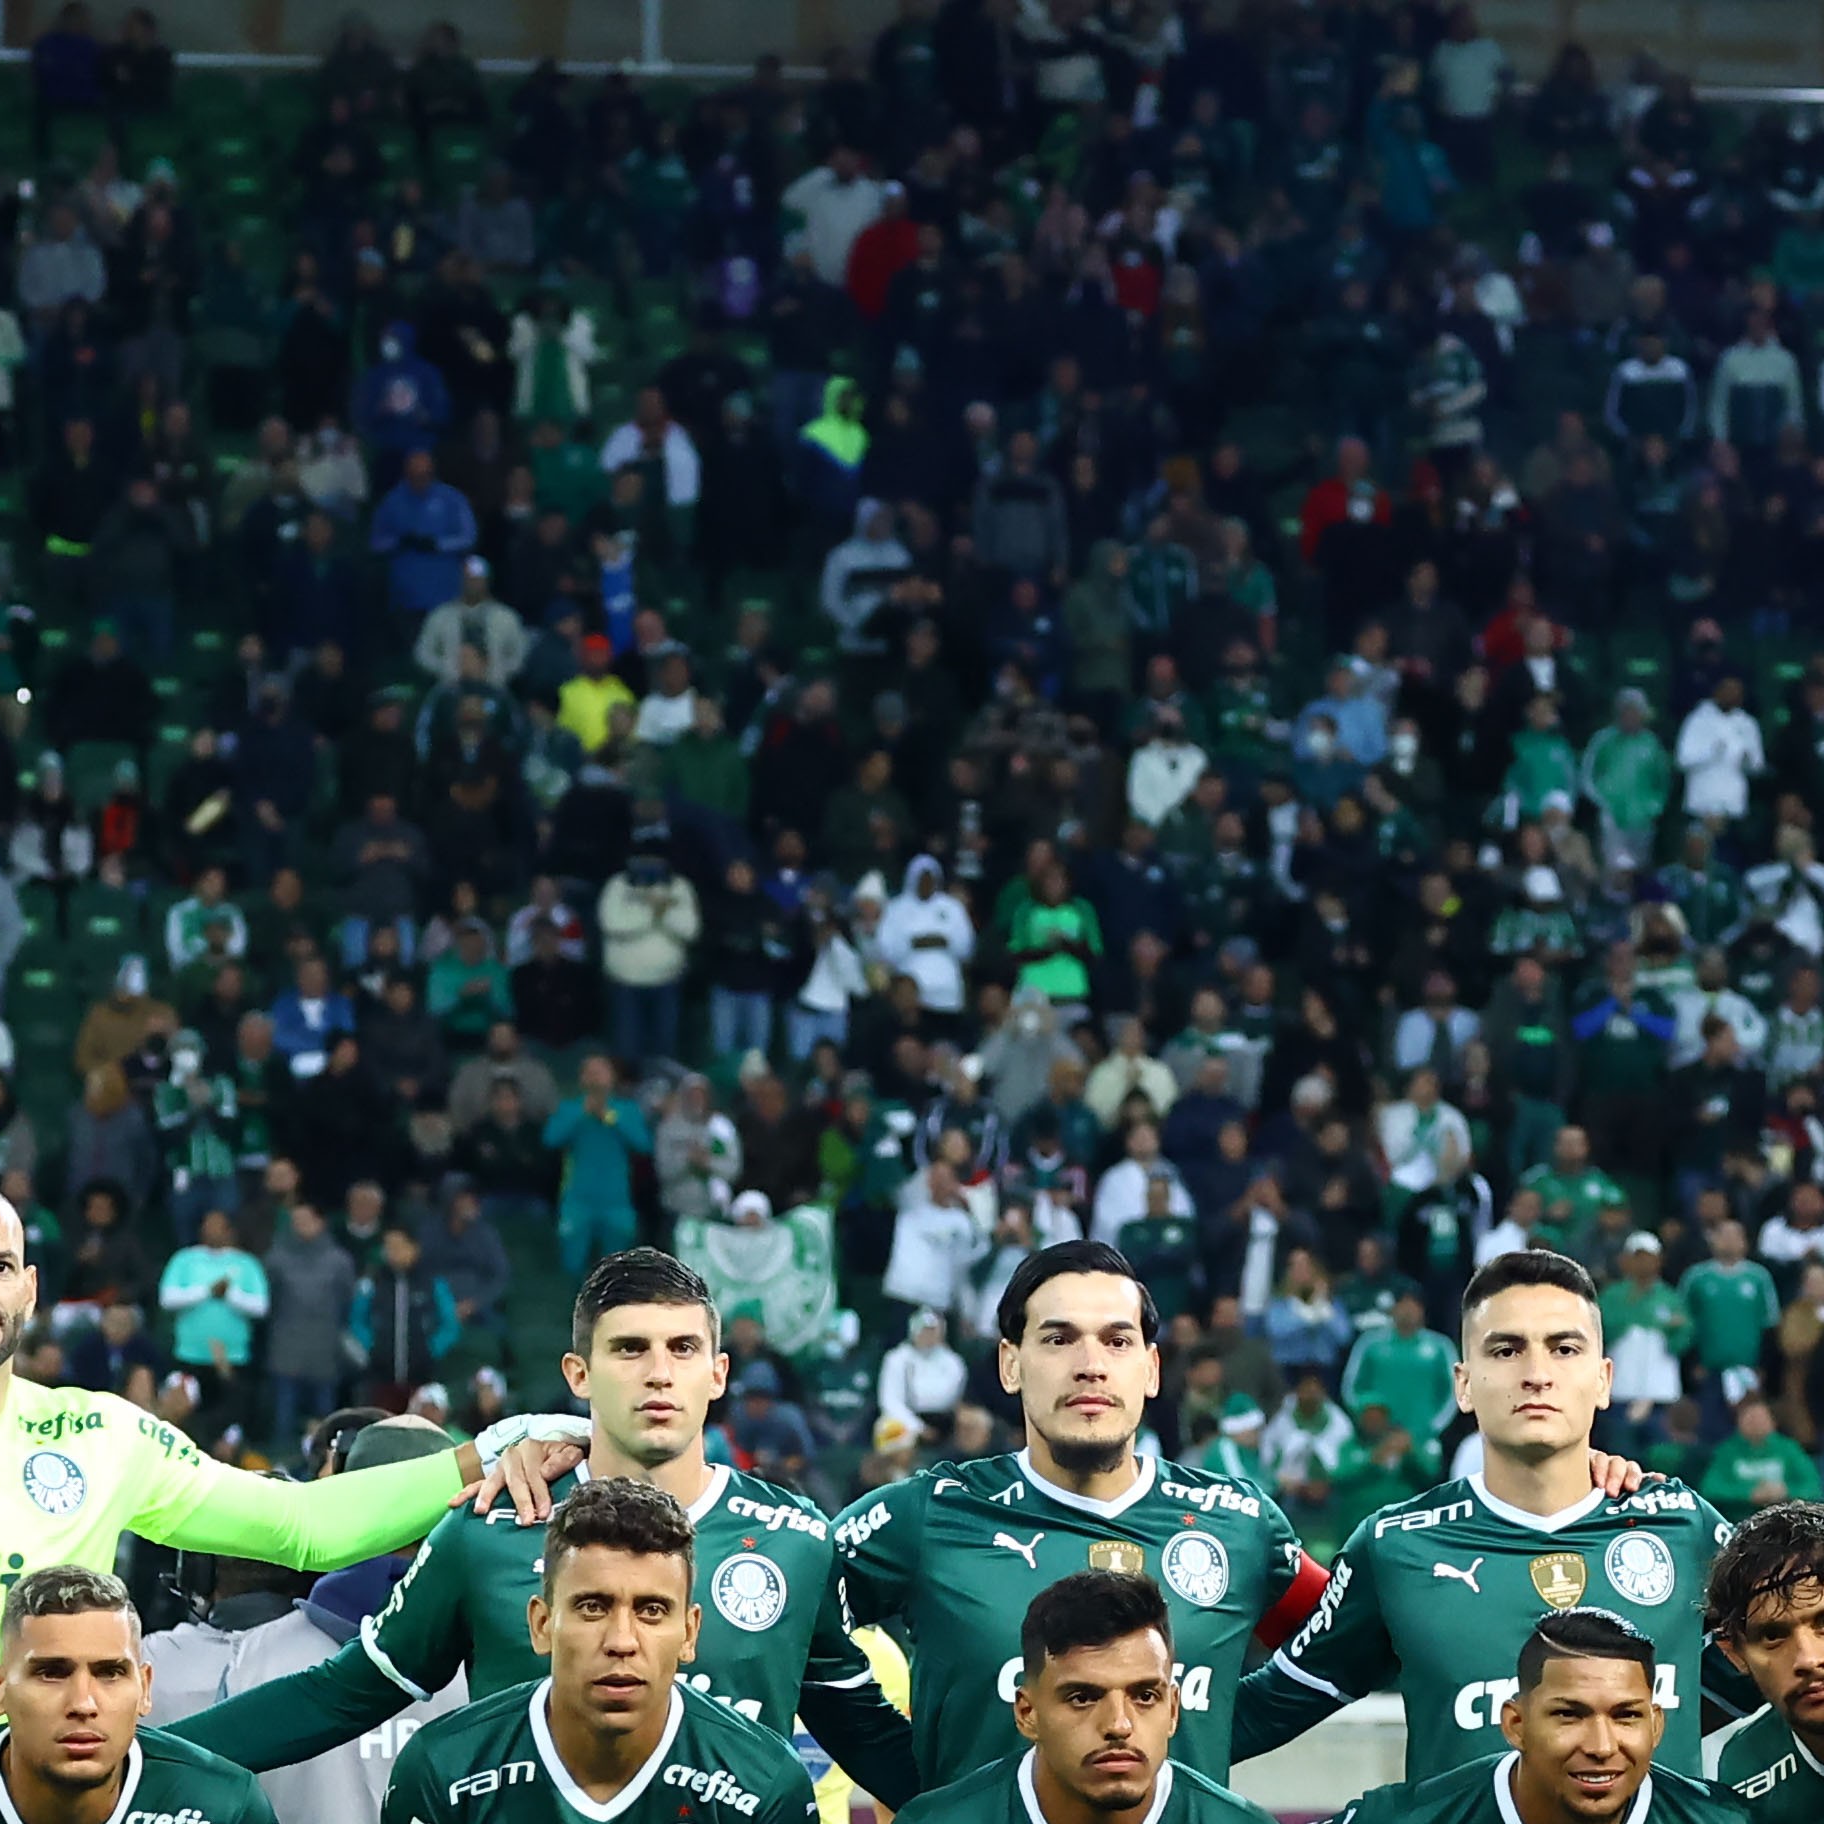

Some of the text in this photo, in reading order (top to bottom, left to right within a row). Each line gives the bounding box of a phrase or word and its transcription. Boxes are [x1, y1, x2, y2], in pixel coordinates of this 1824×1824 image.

[728, 1495, 827, 1541] crefisa
[1161, 1480, 1261, 1518] crefisa
[1292, 1559, 1352, 1657] crefisa
[664, 1763, 761, 1817] crefisa
